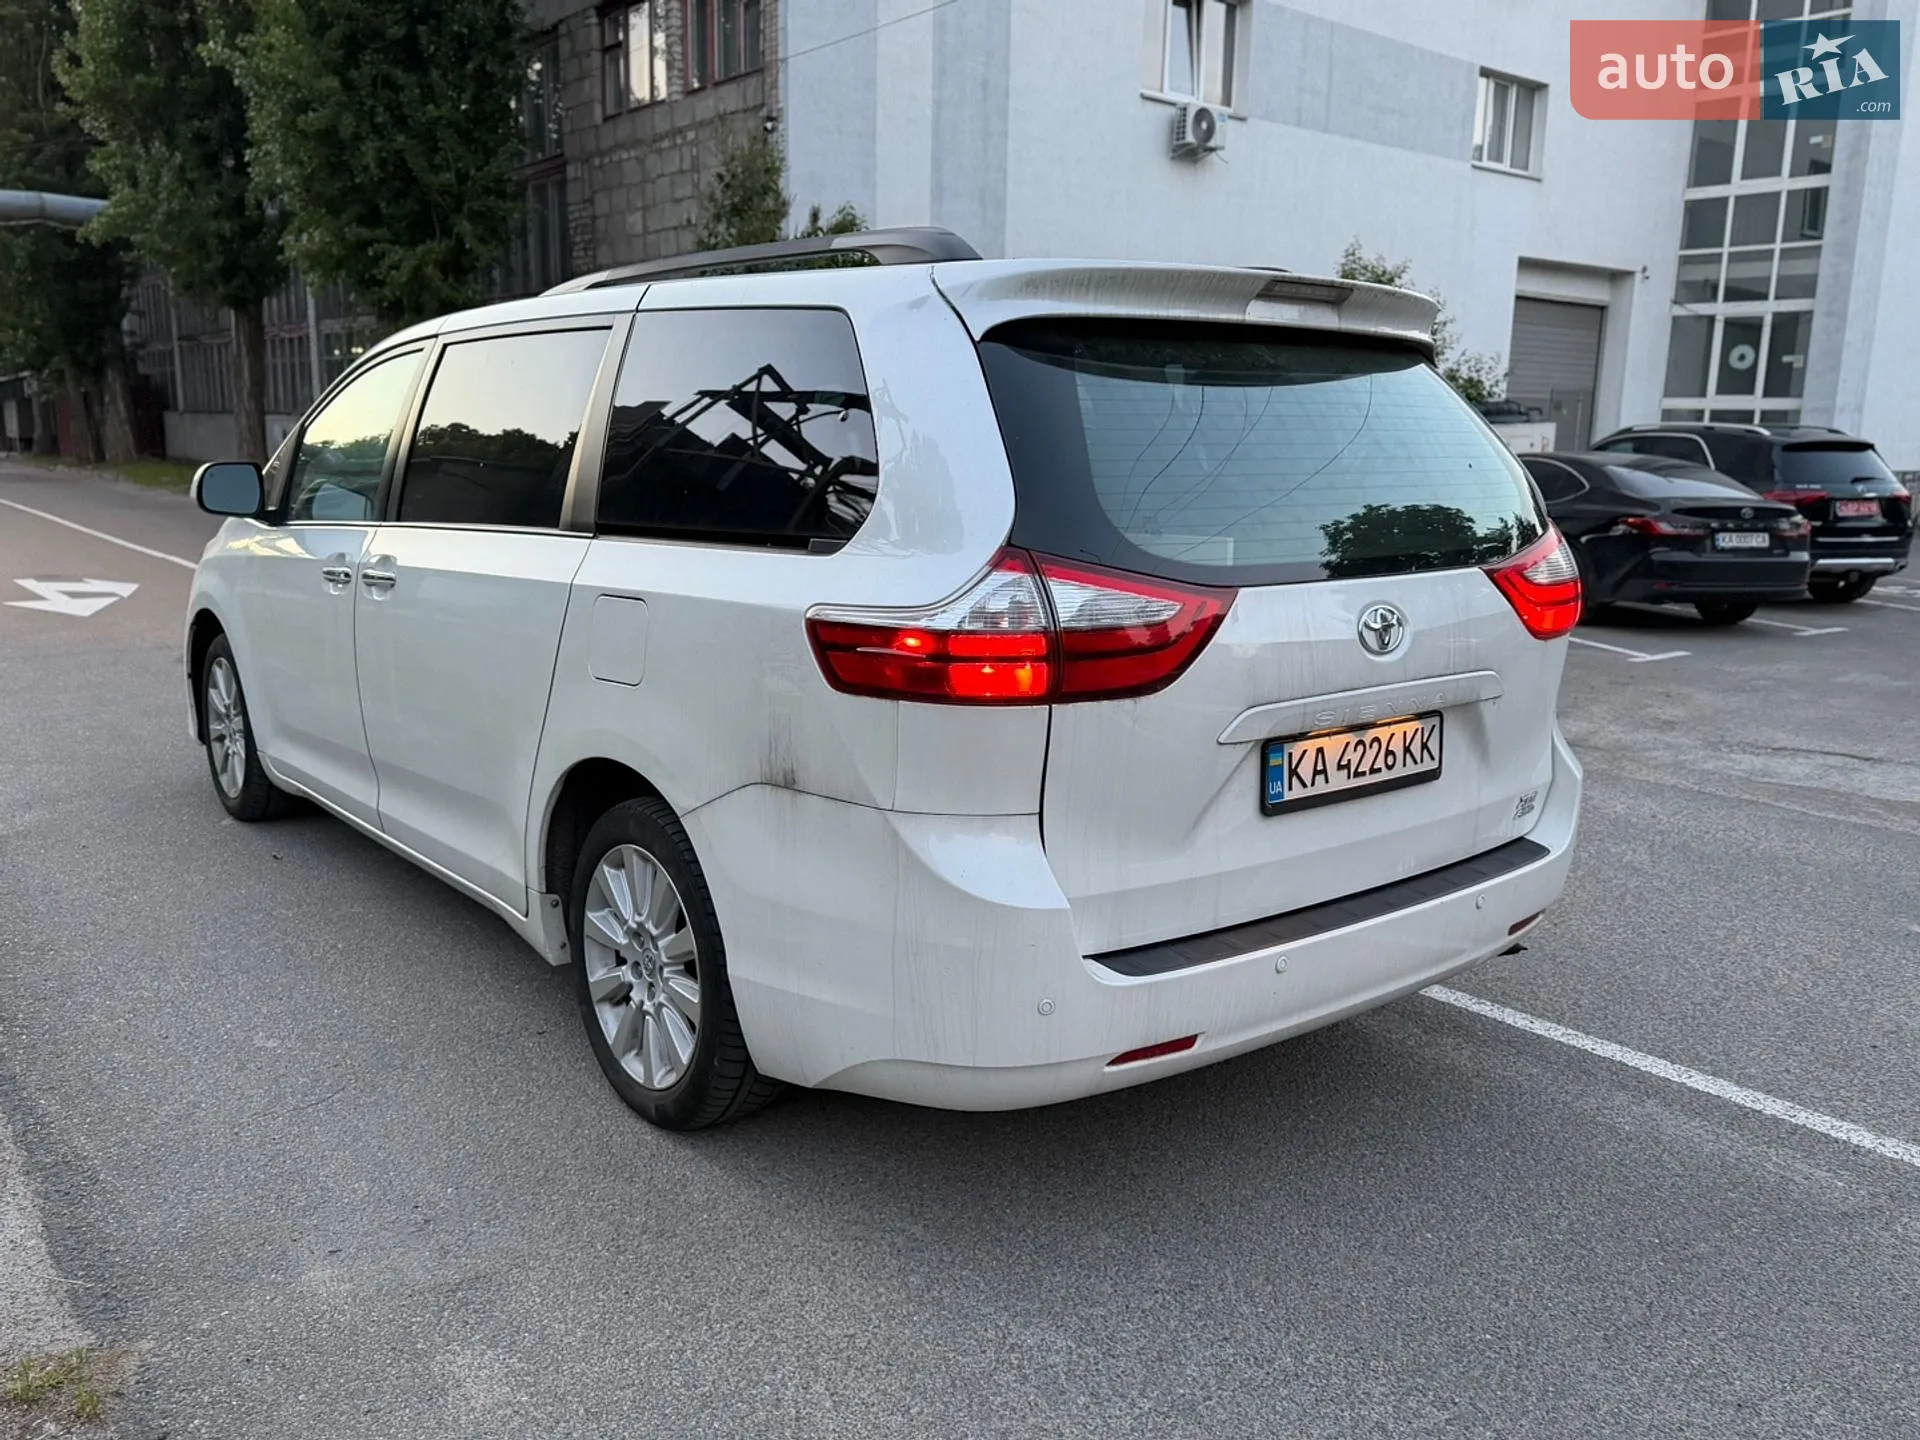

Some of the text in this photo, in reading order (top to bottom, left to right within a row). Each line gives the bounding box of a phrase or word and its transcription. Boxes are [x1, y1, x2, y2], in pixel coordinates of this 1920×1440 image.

[1313, 692, 1446, 726] SIENNA
[1287, 724, 1437, 792] KA 4226 KK
[1269, 781, 1283, 795] UA
